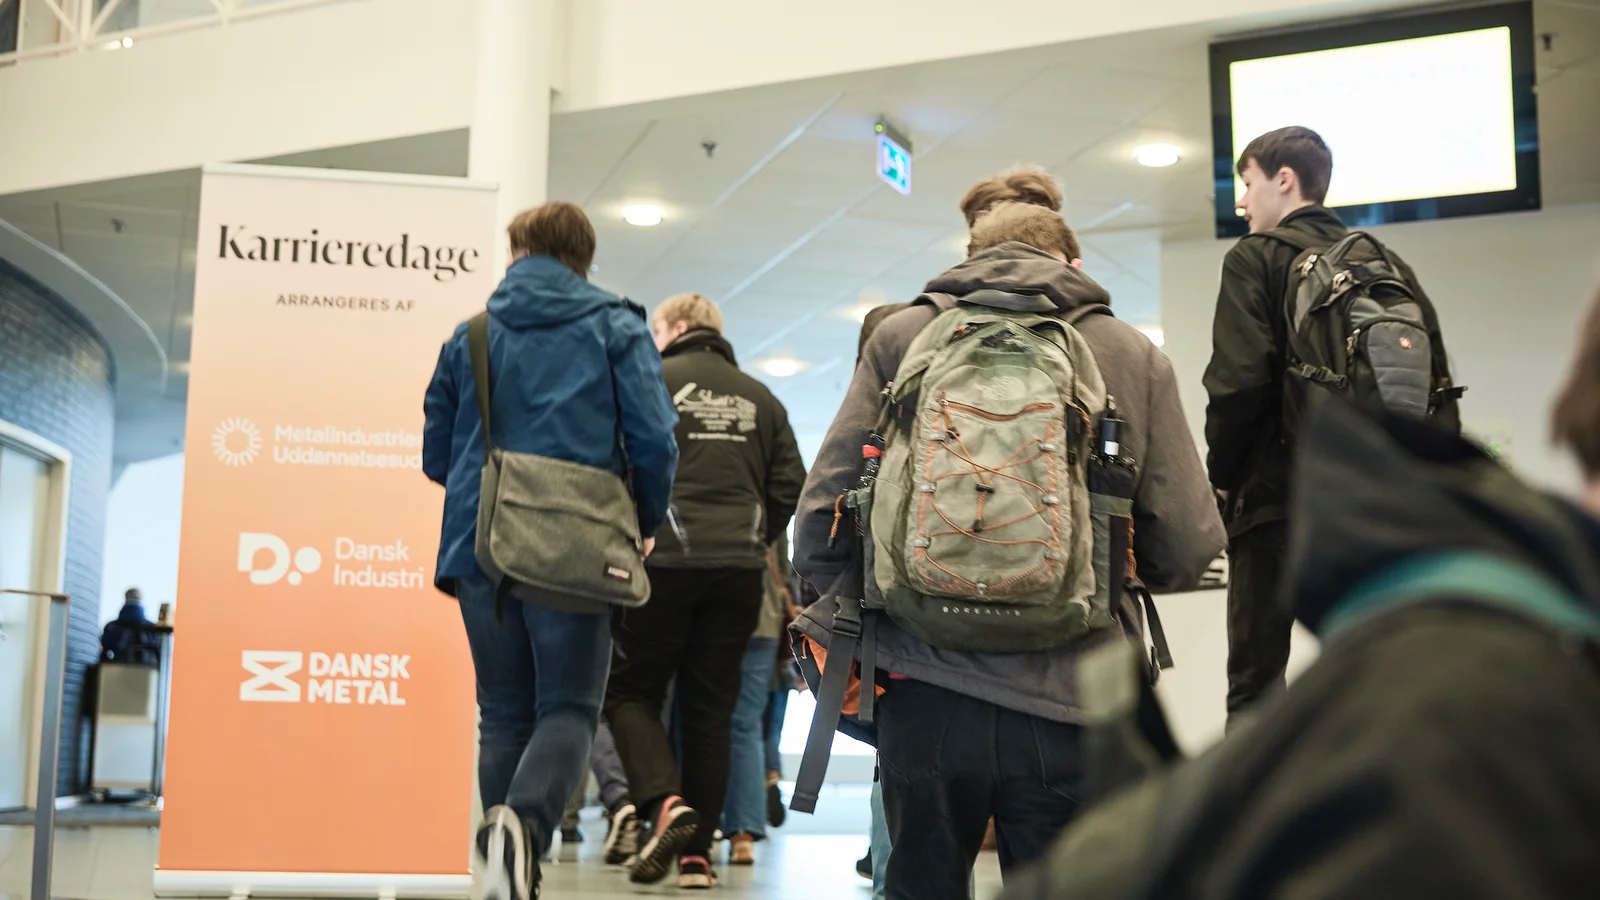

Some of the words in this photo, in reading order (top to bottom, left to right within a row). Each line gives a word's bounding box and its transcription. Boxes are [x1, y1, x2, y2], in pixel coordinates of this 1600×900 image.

[218, 224, 480, 282] Karrieredage
[275, 293, 391, 312] ARRANGERES
[395, 299, 416, 312] AF
[334, 537, 410, 562] Dansk
[333, 565, 424, 588] Industri
[309, 651, 411, 680] DANSK
[307, 679, 406, 706] METAL
